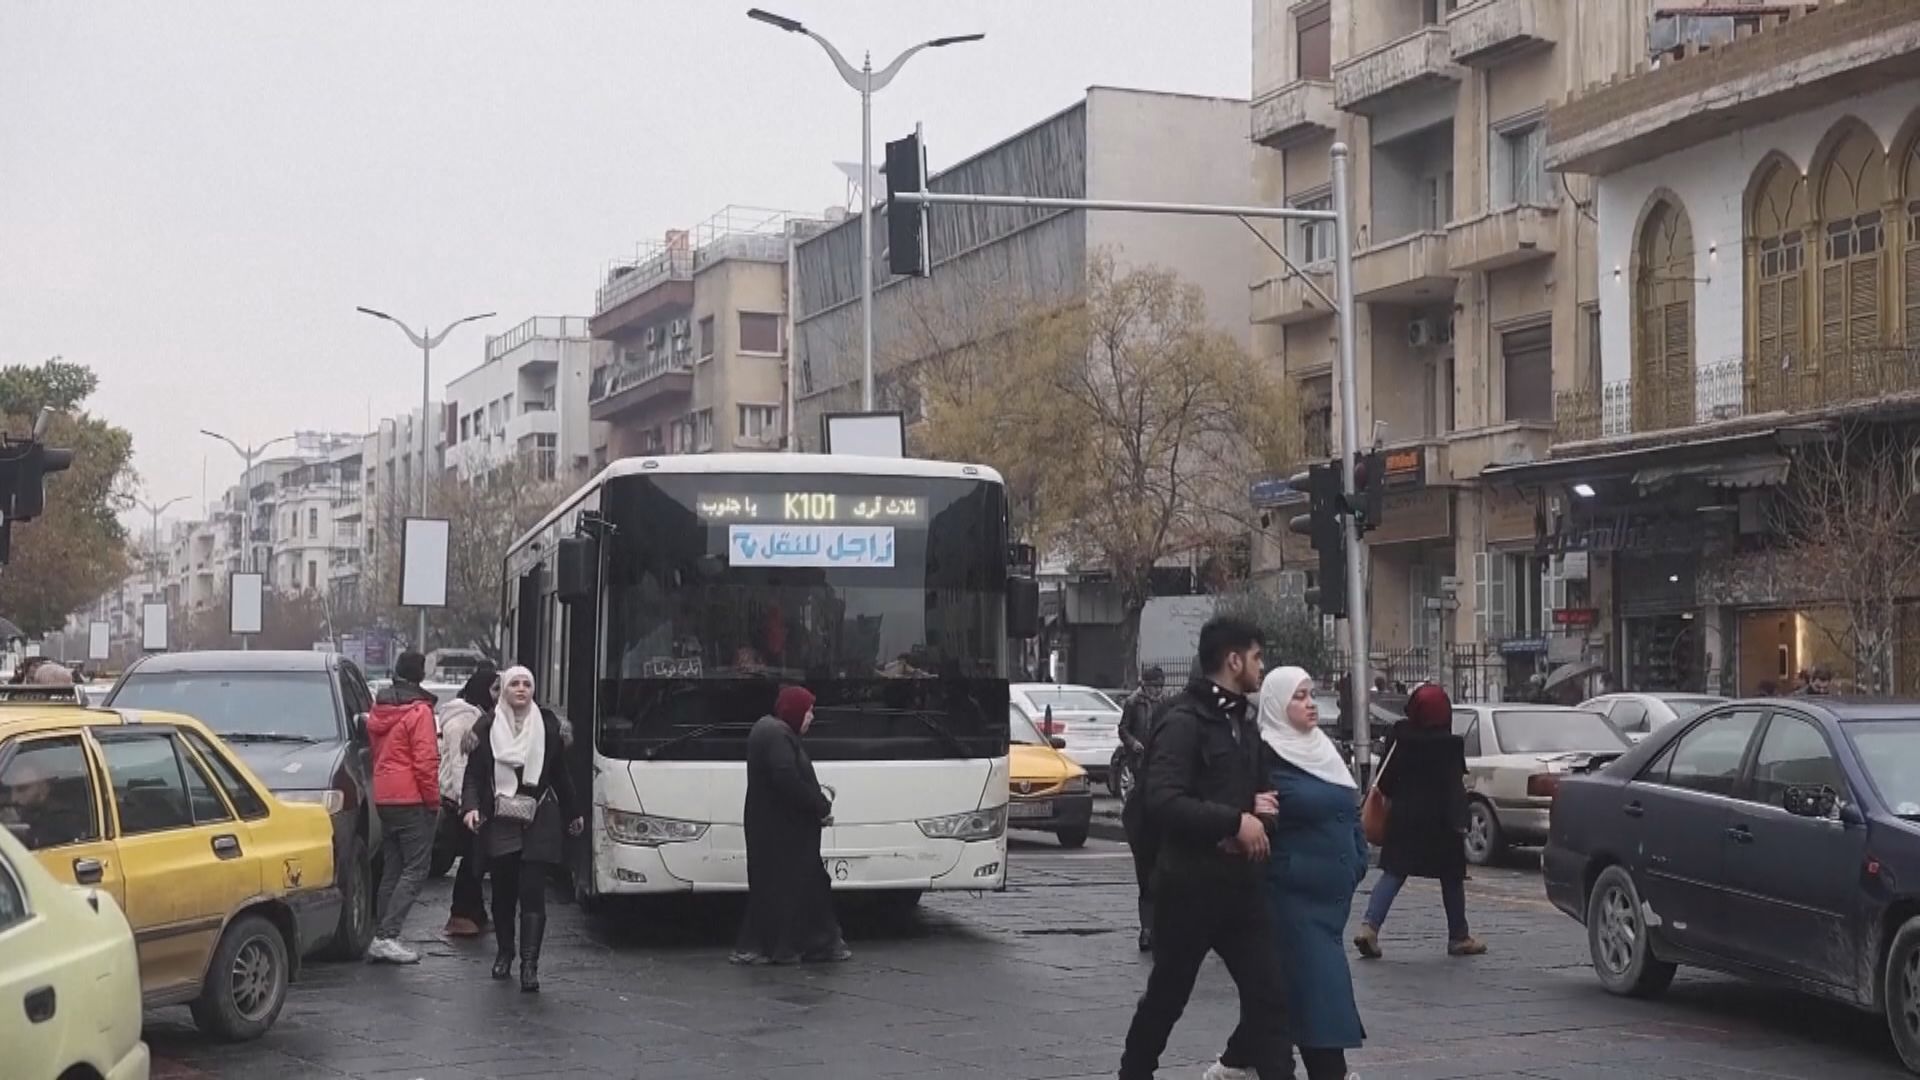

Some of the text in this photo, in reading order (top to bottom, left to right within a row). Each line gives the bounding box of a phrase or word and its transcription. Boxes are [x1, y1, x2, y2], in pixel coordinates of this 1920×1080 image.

[784, 492, 836, 519] K101
[761, 529, 892, 563] زاجل للنقل
